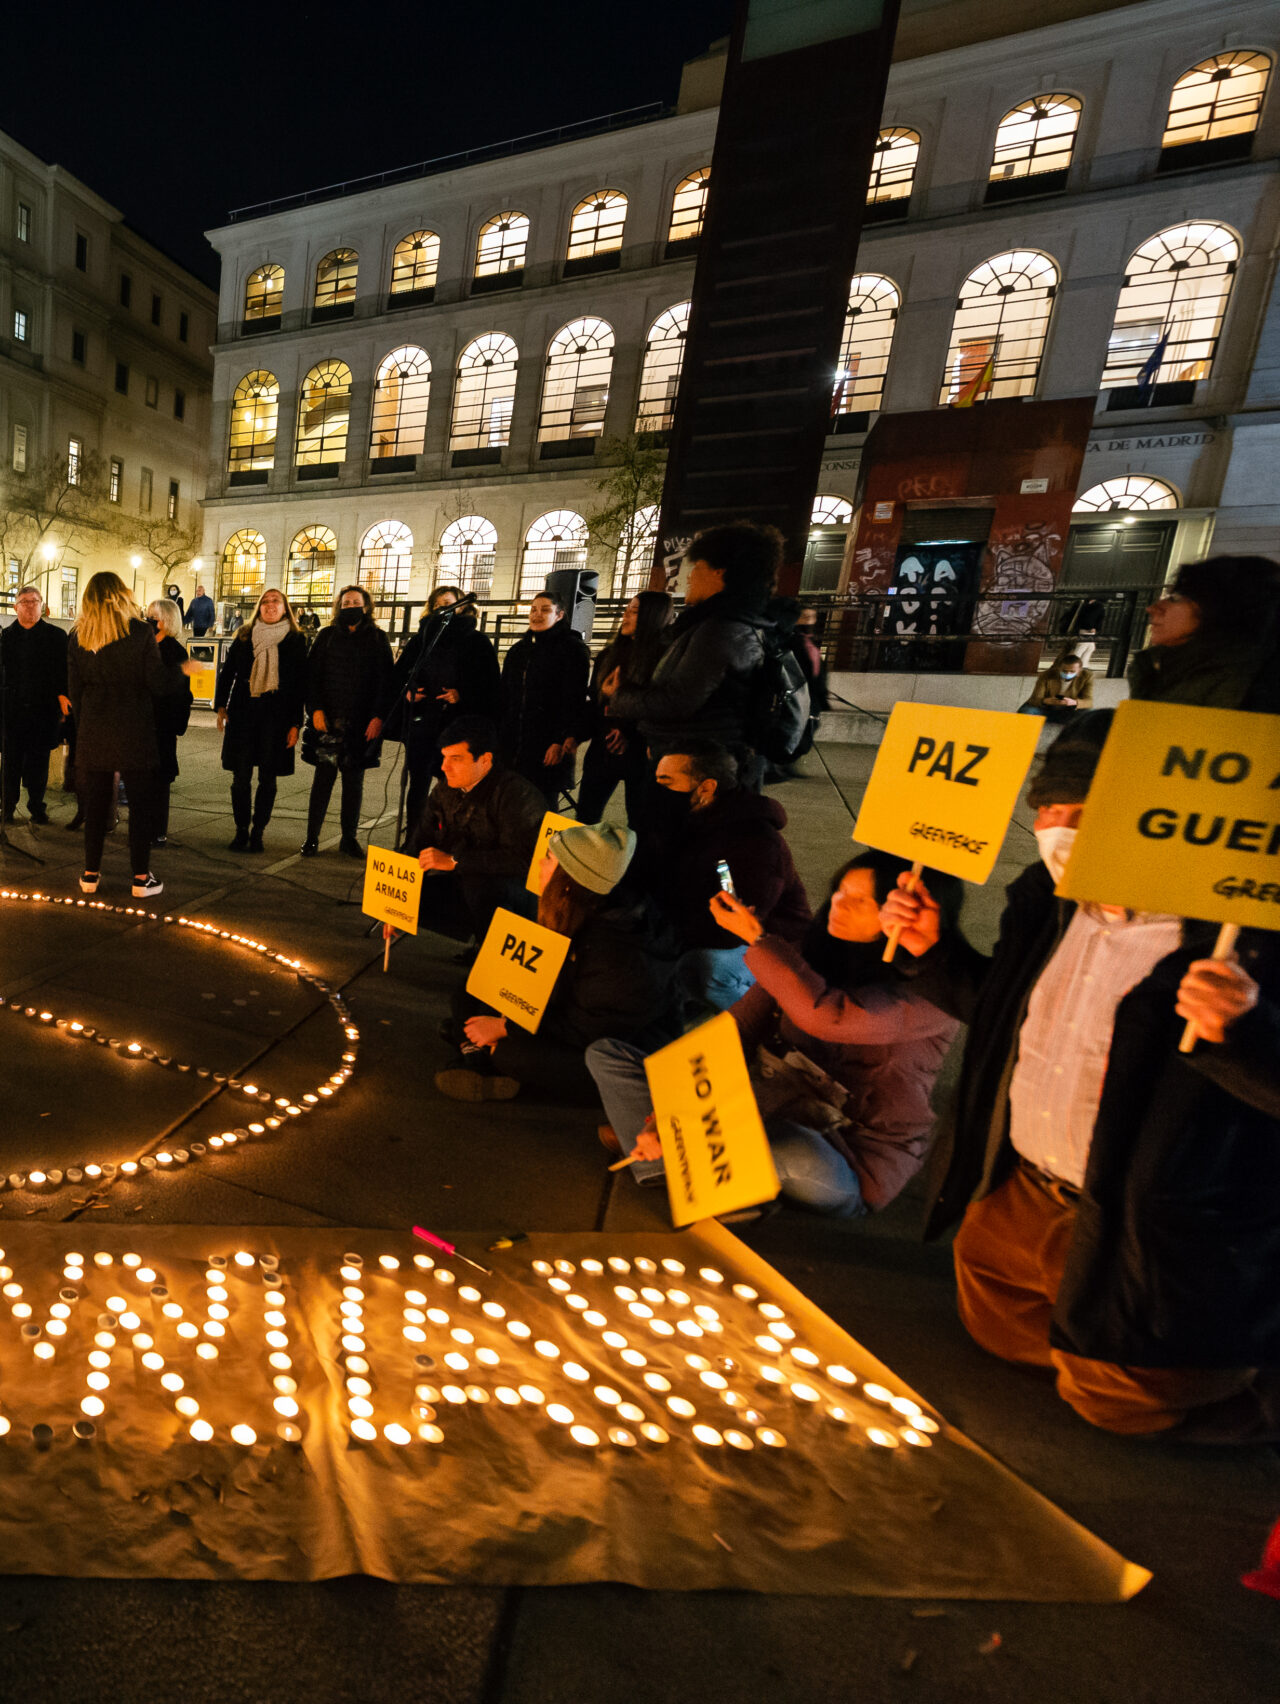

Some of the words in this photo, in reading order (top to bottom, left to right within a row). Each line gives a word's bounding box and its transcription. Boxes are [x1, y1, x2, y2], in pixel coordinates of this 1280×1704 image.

[1108, 440, 1129, 451] DE
[1136, 434, 1215, 449] MADRID
[821, 460, 860, 472] CONSE
[907, 736, 990, 786] PAZ
[1161, 745, 1252, 785] NO
[909, 822, 988, 855] GREENPEACE
[373, 858, 386, 874] NO
[387, 864, 394, 876] A
[397, 869, 416, 884] LAS
[375, 881, 408, 903] ARMAS
[1212, 876, 1280, 904] GRE
[500, 933, 544, 973] PAZ
[499, 987, 539, 1016] GREENPEACE
[688, 1051, 712, 1099] NO
[701, 1105, 732, 1188] WAR
